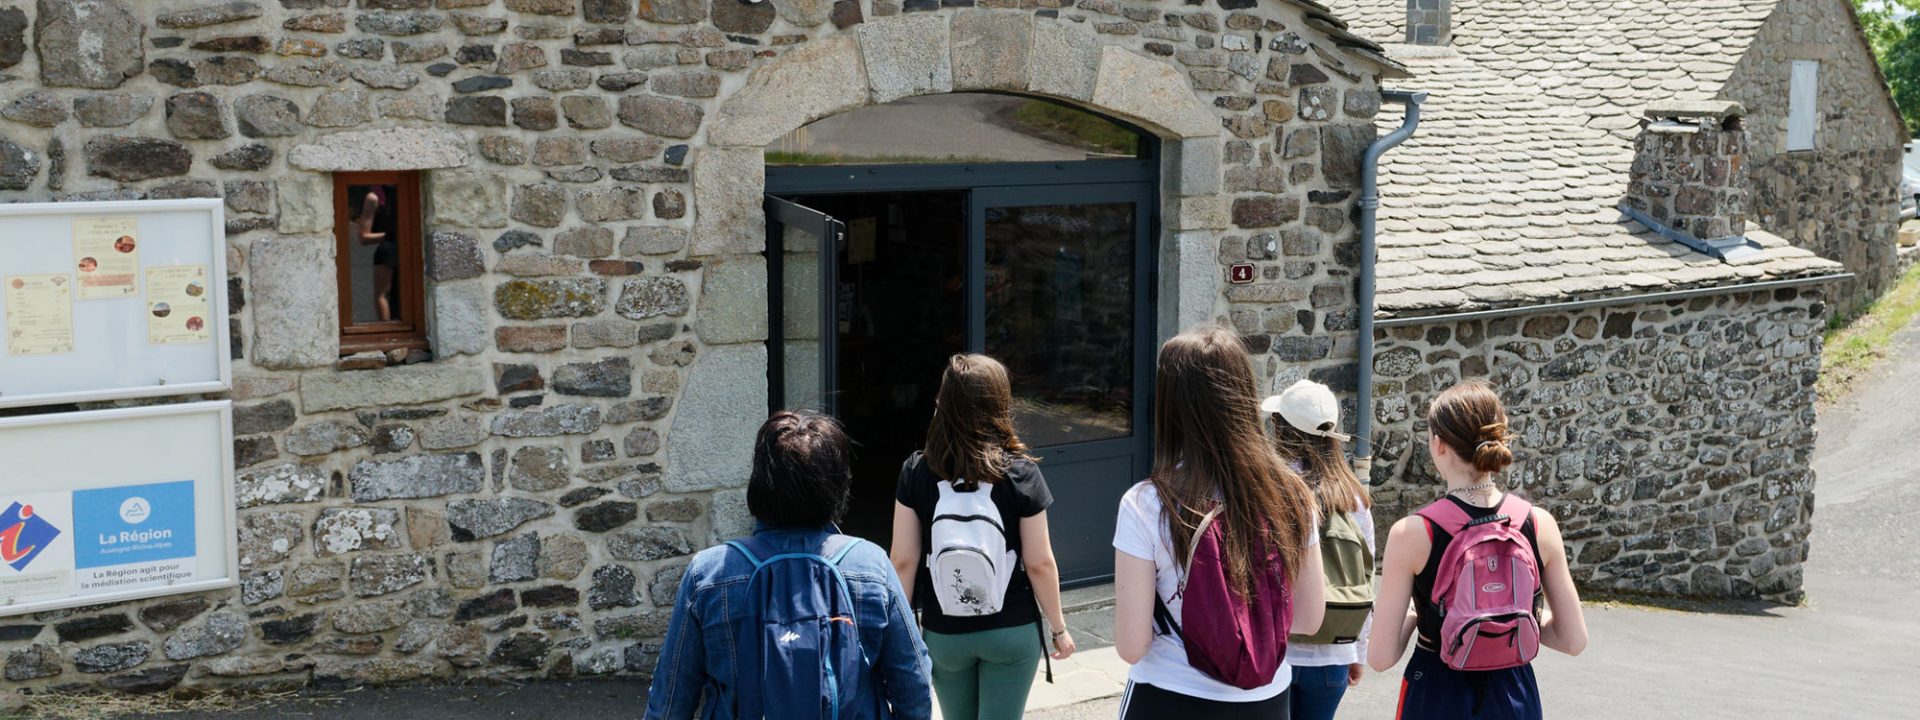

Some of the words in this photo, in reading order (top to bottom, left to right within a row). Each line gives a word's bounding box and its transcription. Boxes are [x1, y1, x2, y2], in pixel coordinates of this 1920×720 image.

[1238, 267, 1246, 279] 4
[99, 533, 117, 545] La
[120, 528, 172, 543] Région
[91, 577, 138, 588] médiation
[139, 571, 192, 581] scientifique
[93, 571, 104, 579] La
[106, 567, 138, 578] Région
[140, 565, 157, 575] agit
[159, 564, 180, 573] pour
